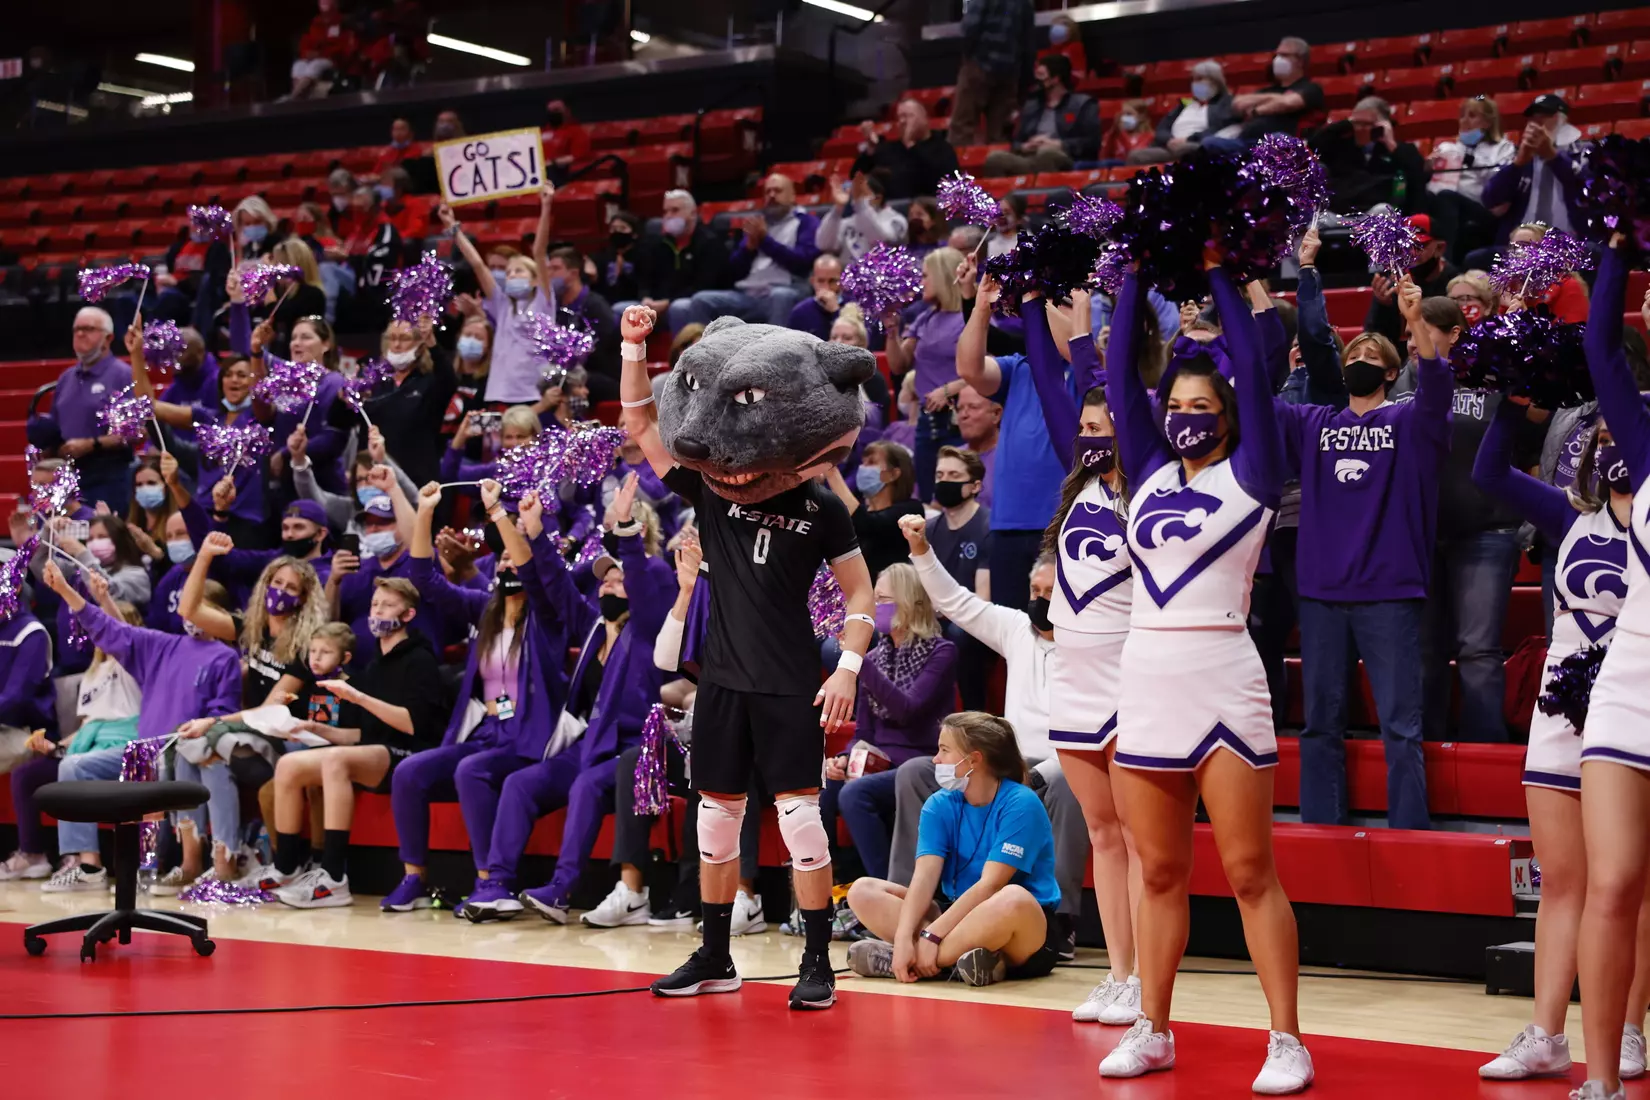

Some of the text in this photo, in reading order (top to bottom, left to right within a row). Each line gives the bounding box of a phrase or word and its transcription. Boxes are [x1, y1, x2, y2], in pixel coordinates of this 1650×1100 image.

[463, 142, 489, 162] GO
[448, 146, 539, 197] CATS!
[1320, 425, 1395, 452] K-STATE
[727, 503, 812, 535] K-STATE
[753, 527, 771, 565] 0
[1002, 842, 1025, 856] NCAA
[1515, 866, 1523, 884] N
